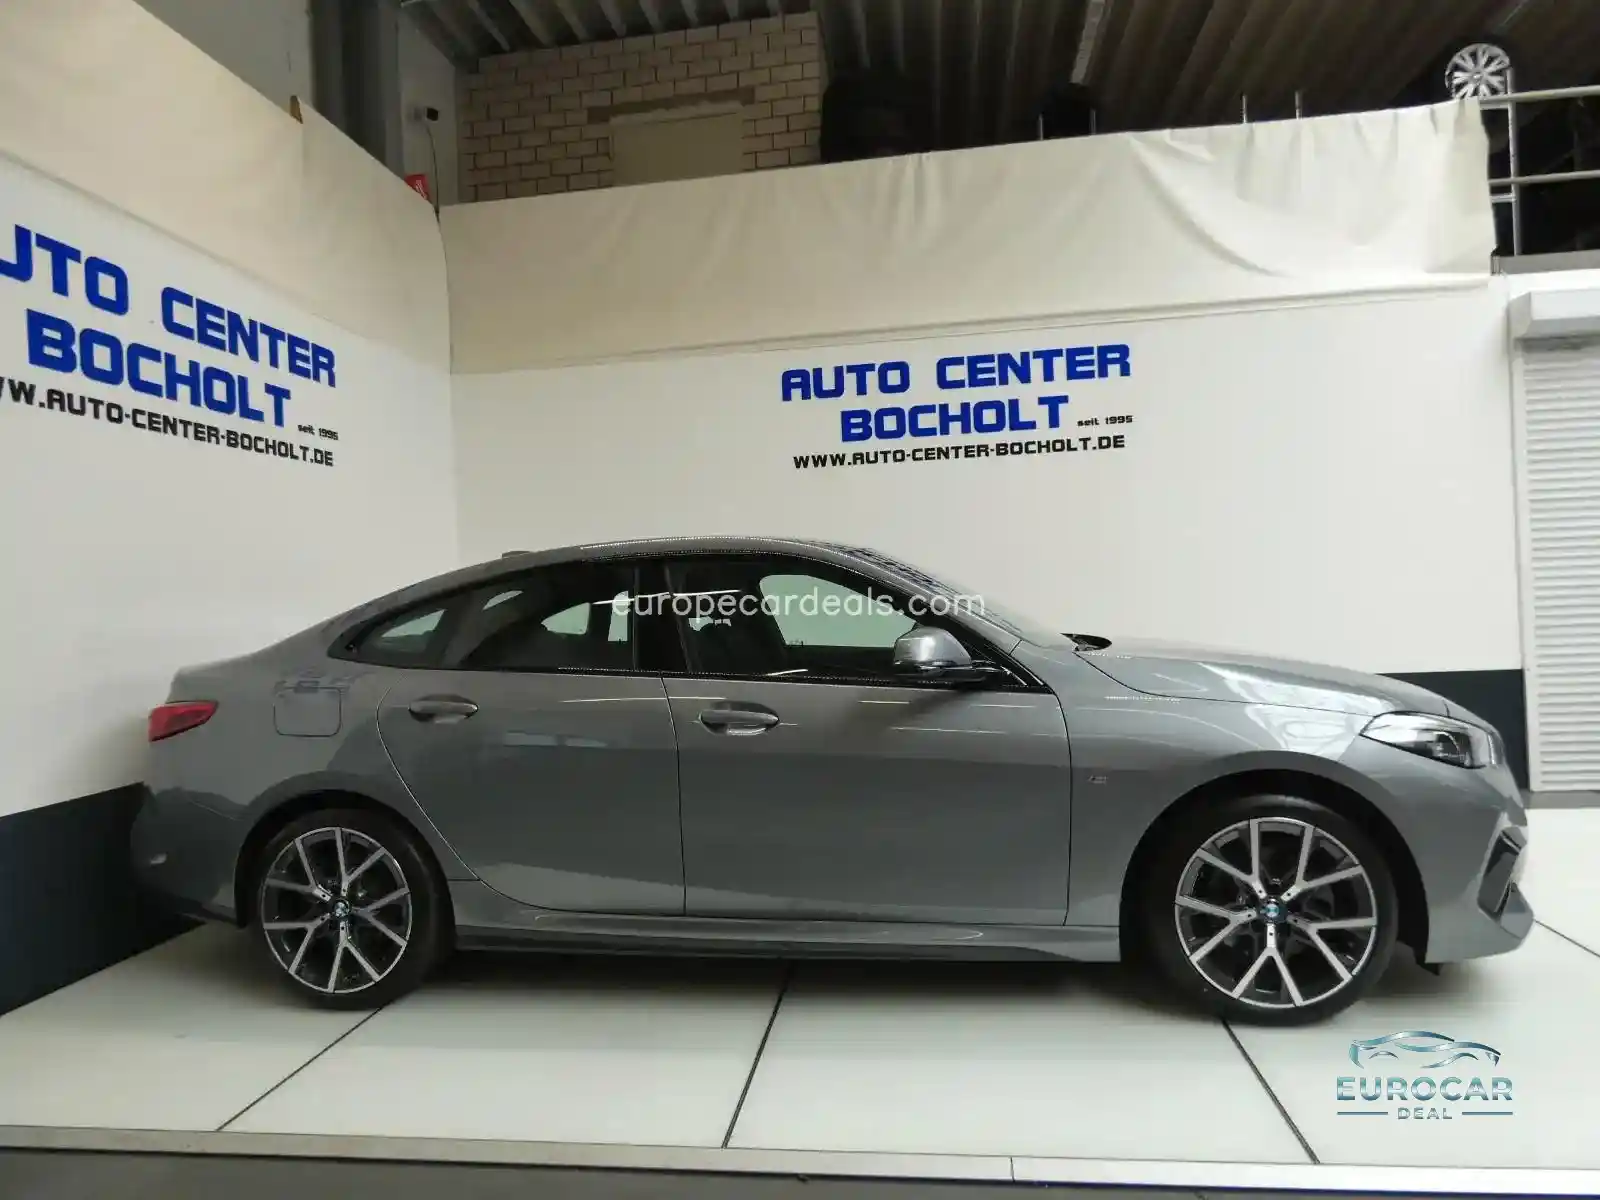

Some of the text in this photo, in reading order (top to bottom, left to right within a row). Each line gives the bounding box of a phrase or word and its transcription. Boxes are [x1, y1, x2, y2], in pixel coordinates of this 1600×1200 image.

[161, 286, 336, 388] CENTER
[26, 308, 291, 427] BOCHOLT
[782, 344, 1131, 401] AUTO CENTER
[0, 376, 333, 467] W.AUTO-CENTER-BOCHOLT.DE
[840, 395, 1069, 442] BOCHOLT
[1077, 415, 1133, 427] seit 1995
[793, 434, 1125, 469] WWW.AUTO-CENTER-BOCHOLT.DE
